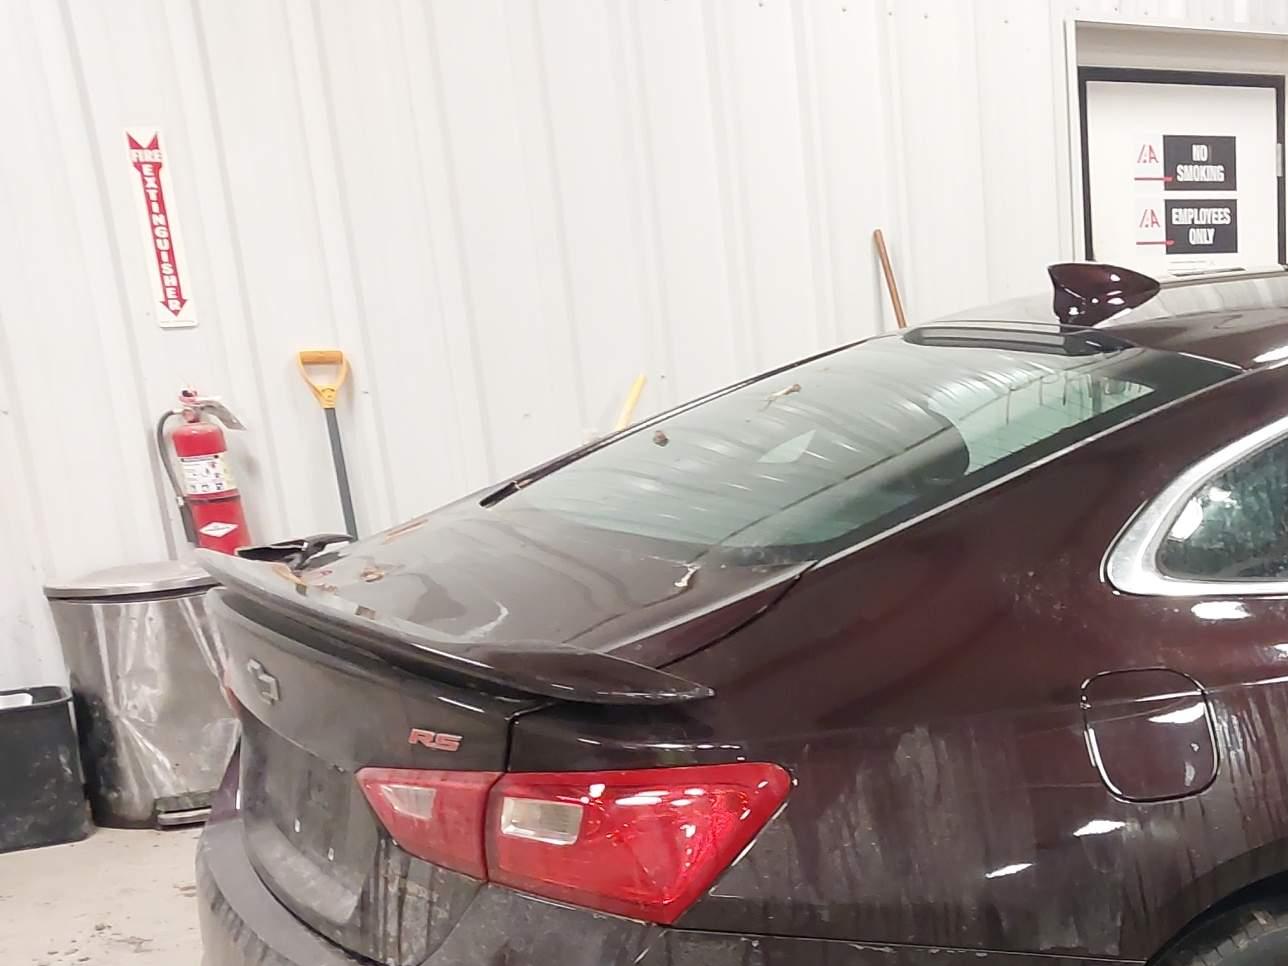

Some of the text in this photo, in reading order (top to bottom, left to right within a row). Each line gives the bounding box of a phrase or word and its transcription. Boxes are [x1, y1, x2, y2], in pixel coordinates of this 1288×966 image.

[131, 150, 163, 162] FIRE
[1191, 144, 1209, 162] NO
[1176, 164, 1225, 182] SMOKING
[1171, 207, 1231, 225] EMPLOYEES
[142, 163, 182, 311] EXTINGUISHER
[1188, 228, 1215, 245] ONLY
[408, 728, 463, 752] RS
